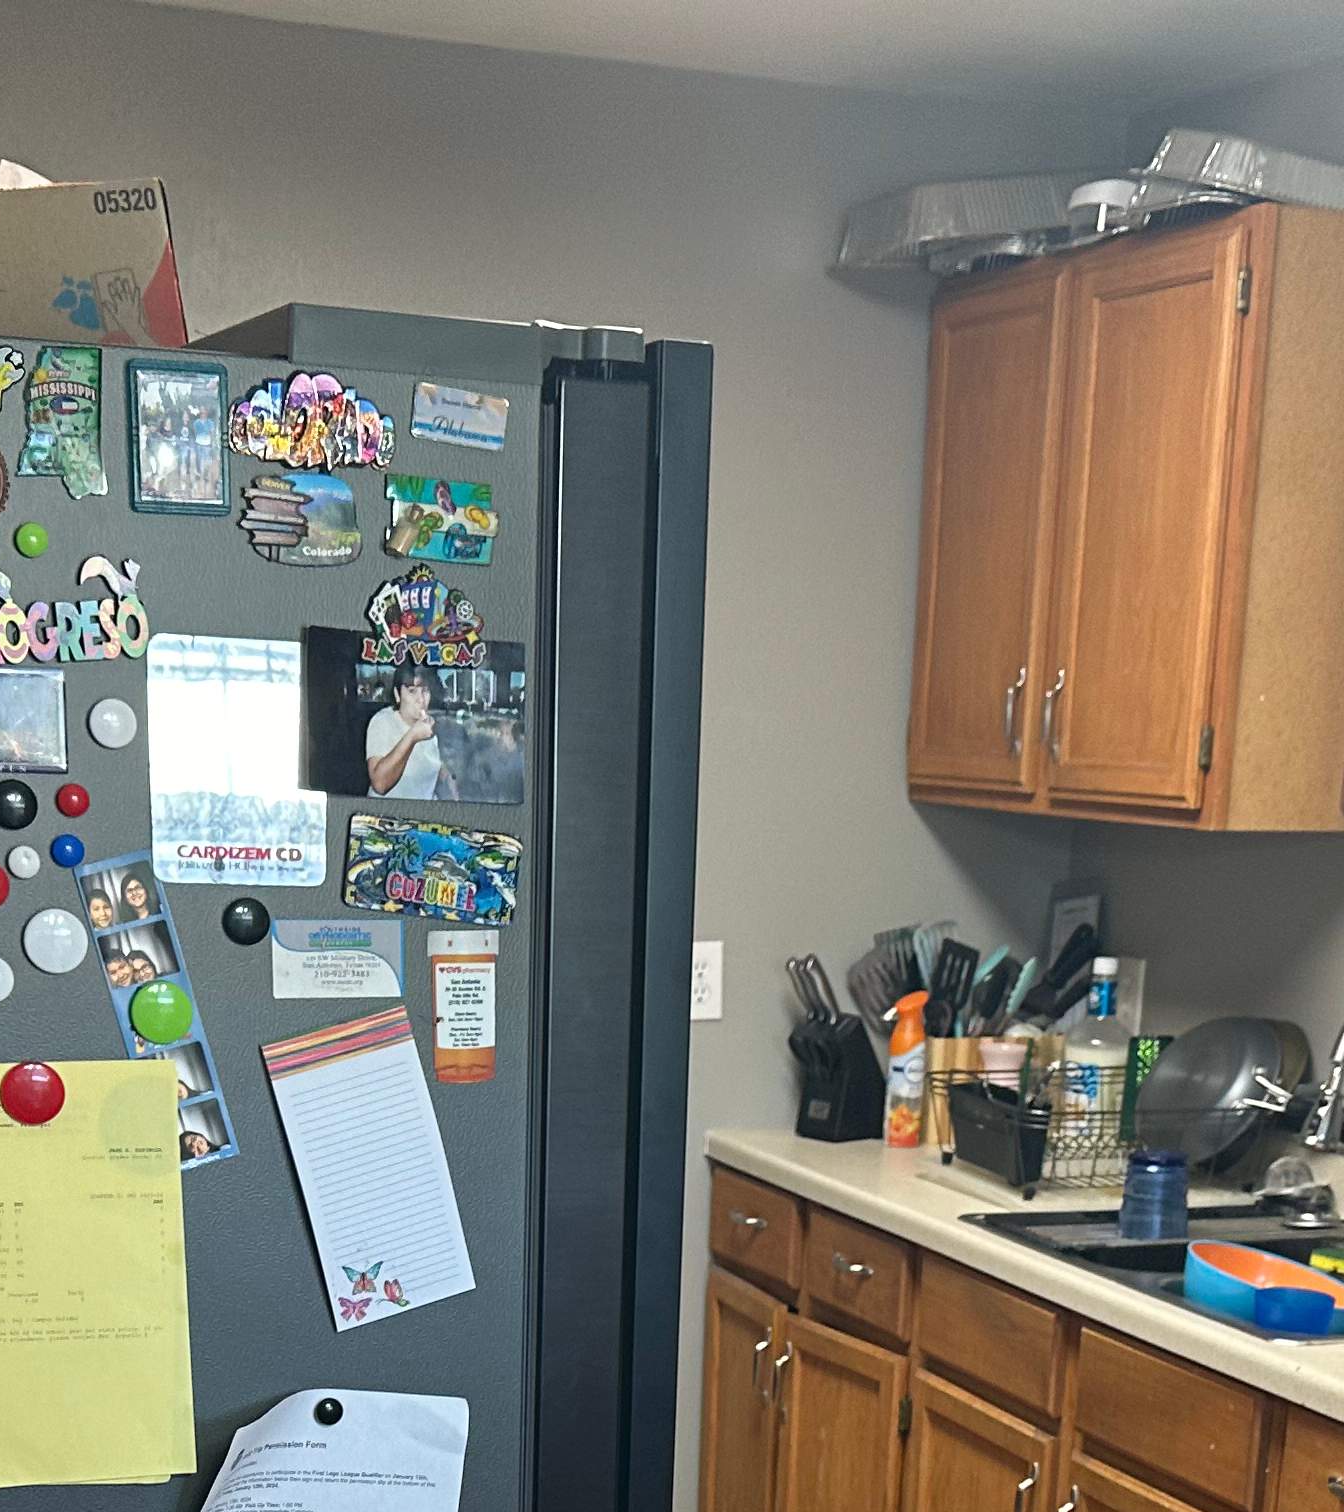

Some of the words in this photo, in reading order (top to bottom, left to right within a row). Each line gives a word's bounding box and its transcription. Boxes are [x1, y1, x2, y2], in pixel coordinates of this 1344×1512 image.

[93, 188, 156, 214] 05320
[30, 381, 96, 401] MISSISSIPPI
[302, 545, 353, 559] Colorado
[361, 638, 409, 664] LAS
[410, 640, 487, 667] VEGAS
[177, 844, 271, 861] CARDIZEM
[276, 848, 303, 863] CD
